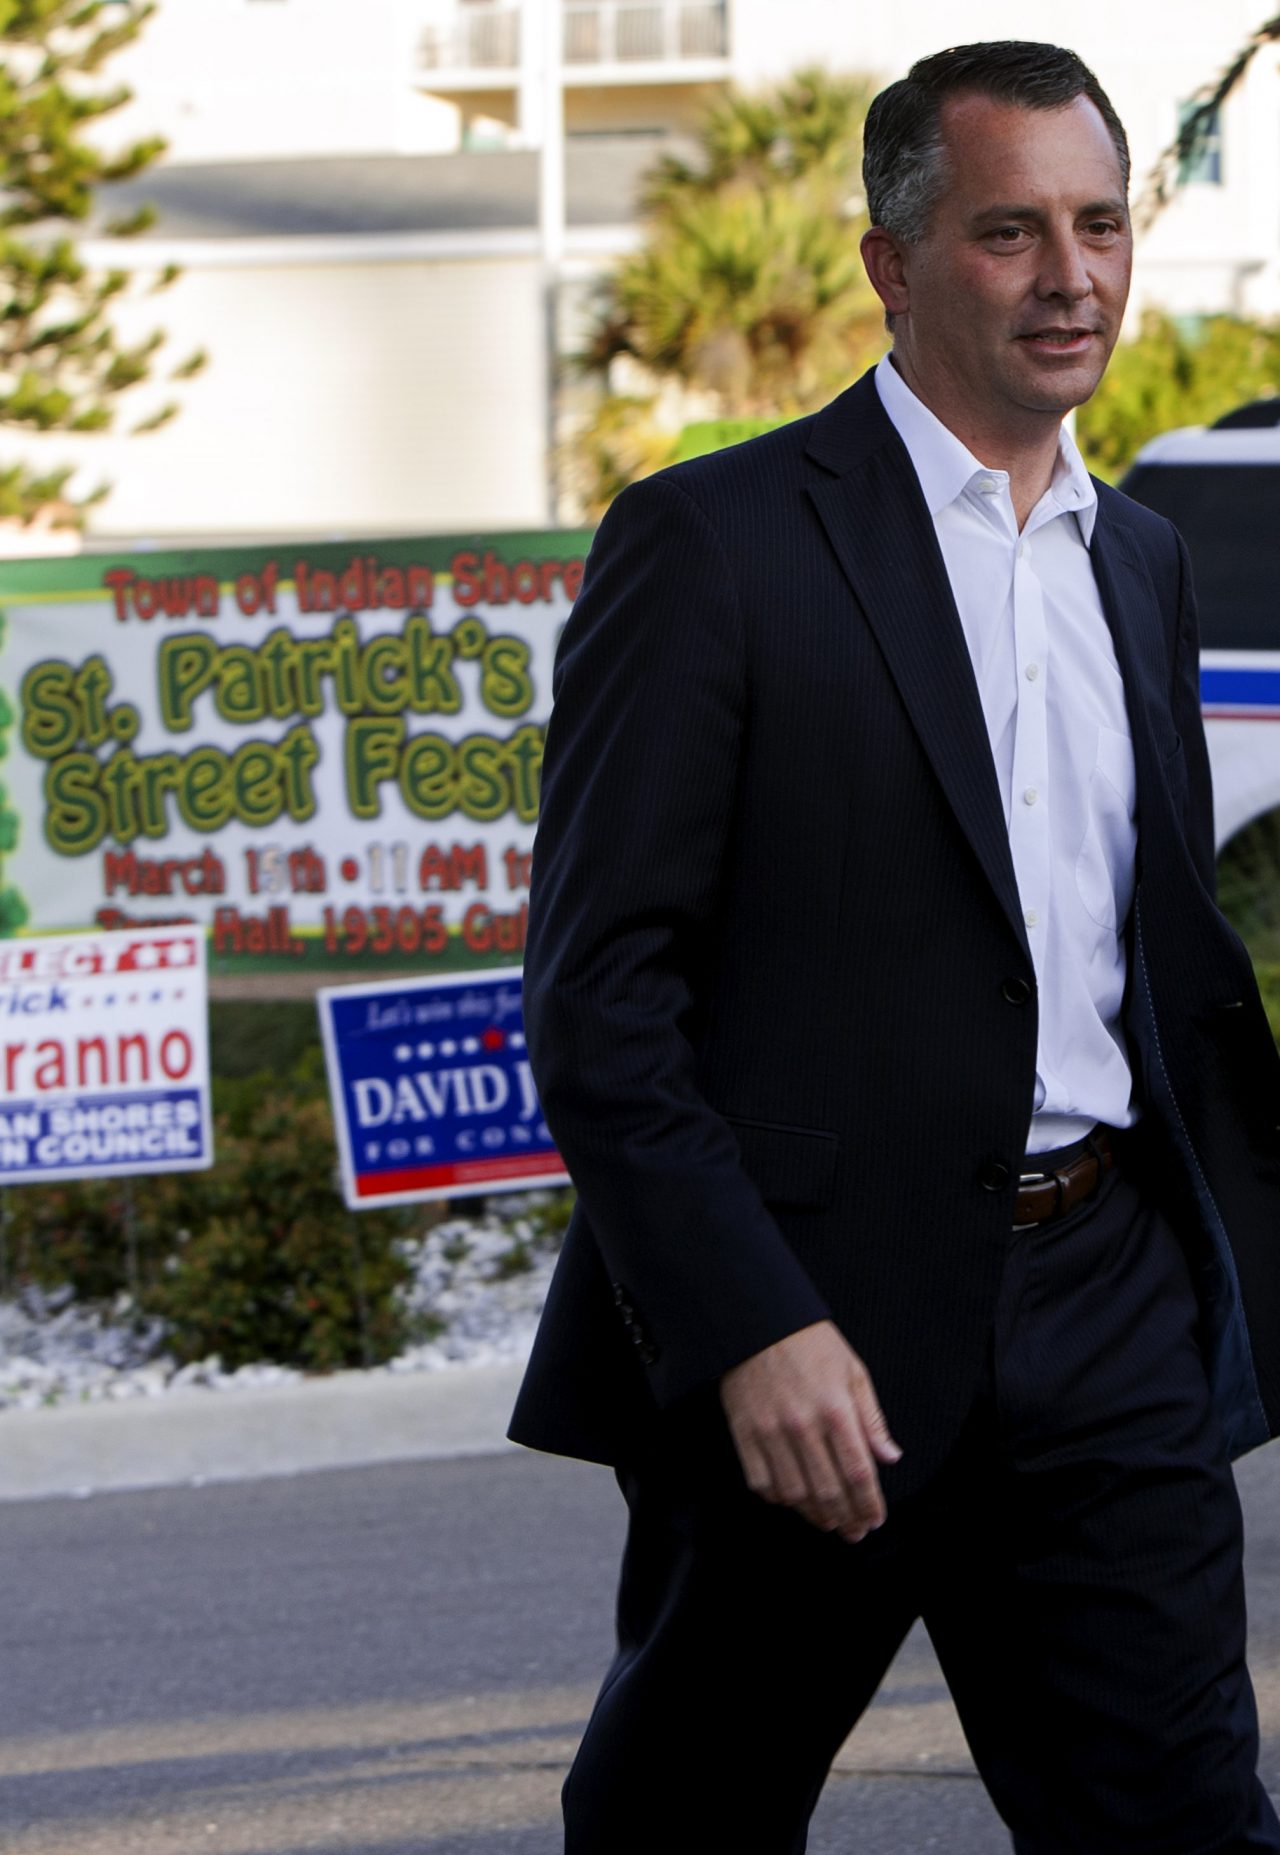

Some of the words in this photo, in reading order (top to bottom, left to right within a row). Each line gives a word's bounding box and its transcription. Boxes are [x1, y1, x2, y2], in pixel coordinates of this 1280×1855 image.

[104, 568, 221, 622] Town
[235, 562, 280, 614] of
[295, 556, 435, 612] Indian
[22, 656, 141, 759] St.
[158, 613, 536, 732] Patrick's
[44, 722, 320, 857] Street
[345, 716, 548, 824] Fest
[103, 847, 226, 897] March
[418, 841, 489, 892] AM
[212, 904, 306, 956] Hall,
[323, 902, 449, 955] 19305
[0, 941, 124, 981] LECT
[4, 1028, 195, 1093] ranno
[50, 1099, 198, 1137] SHORES
[353, 1064, 510, 1128] DAVID
[35, 1128, 199, 1165] COUNCIL
